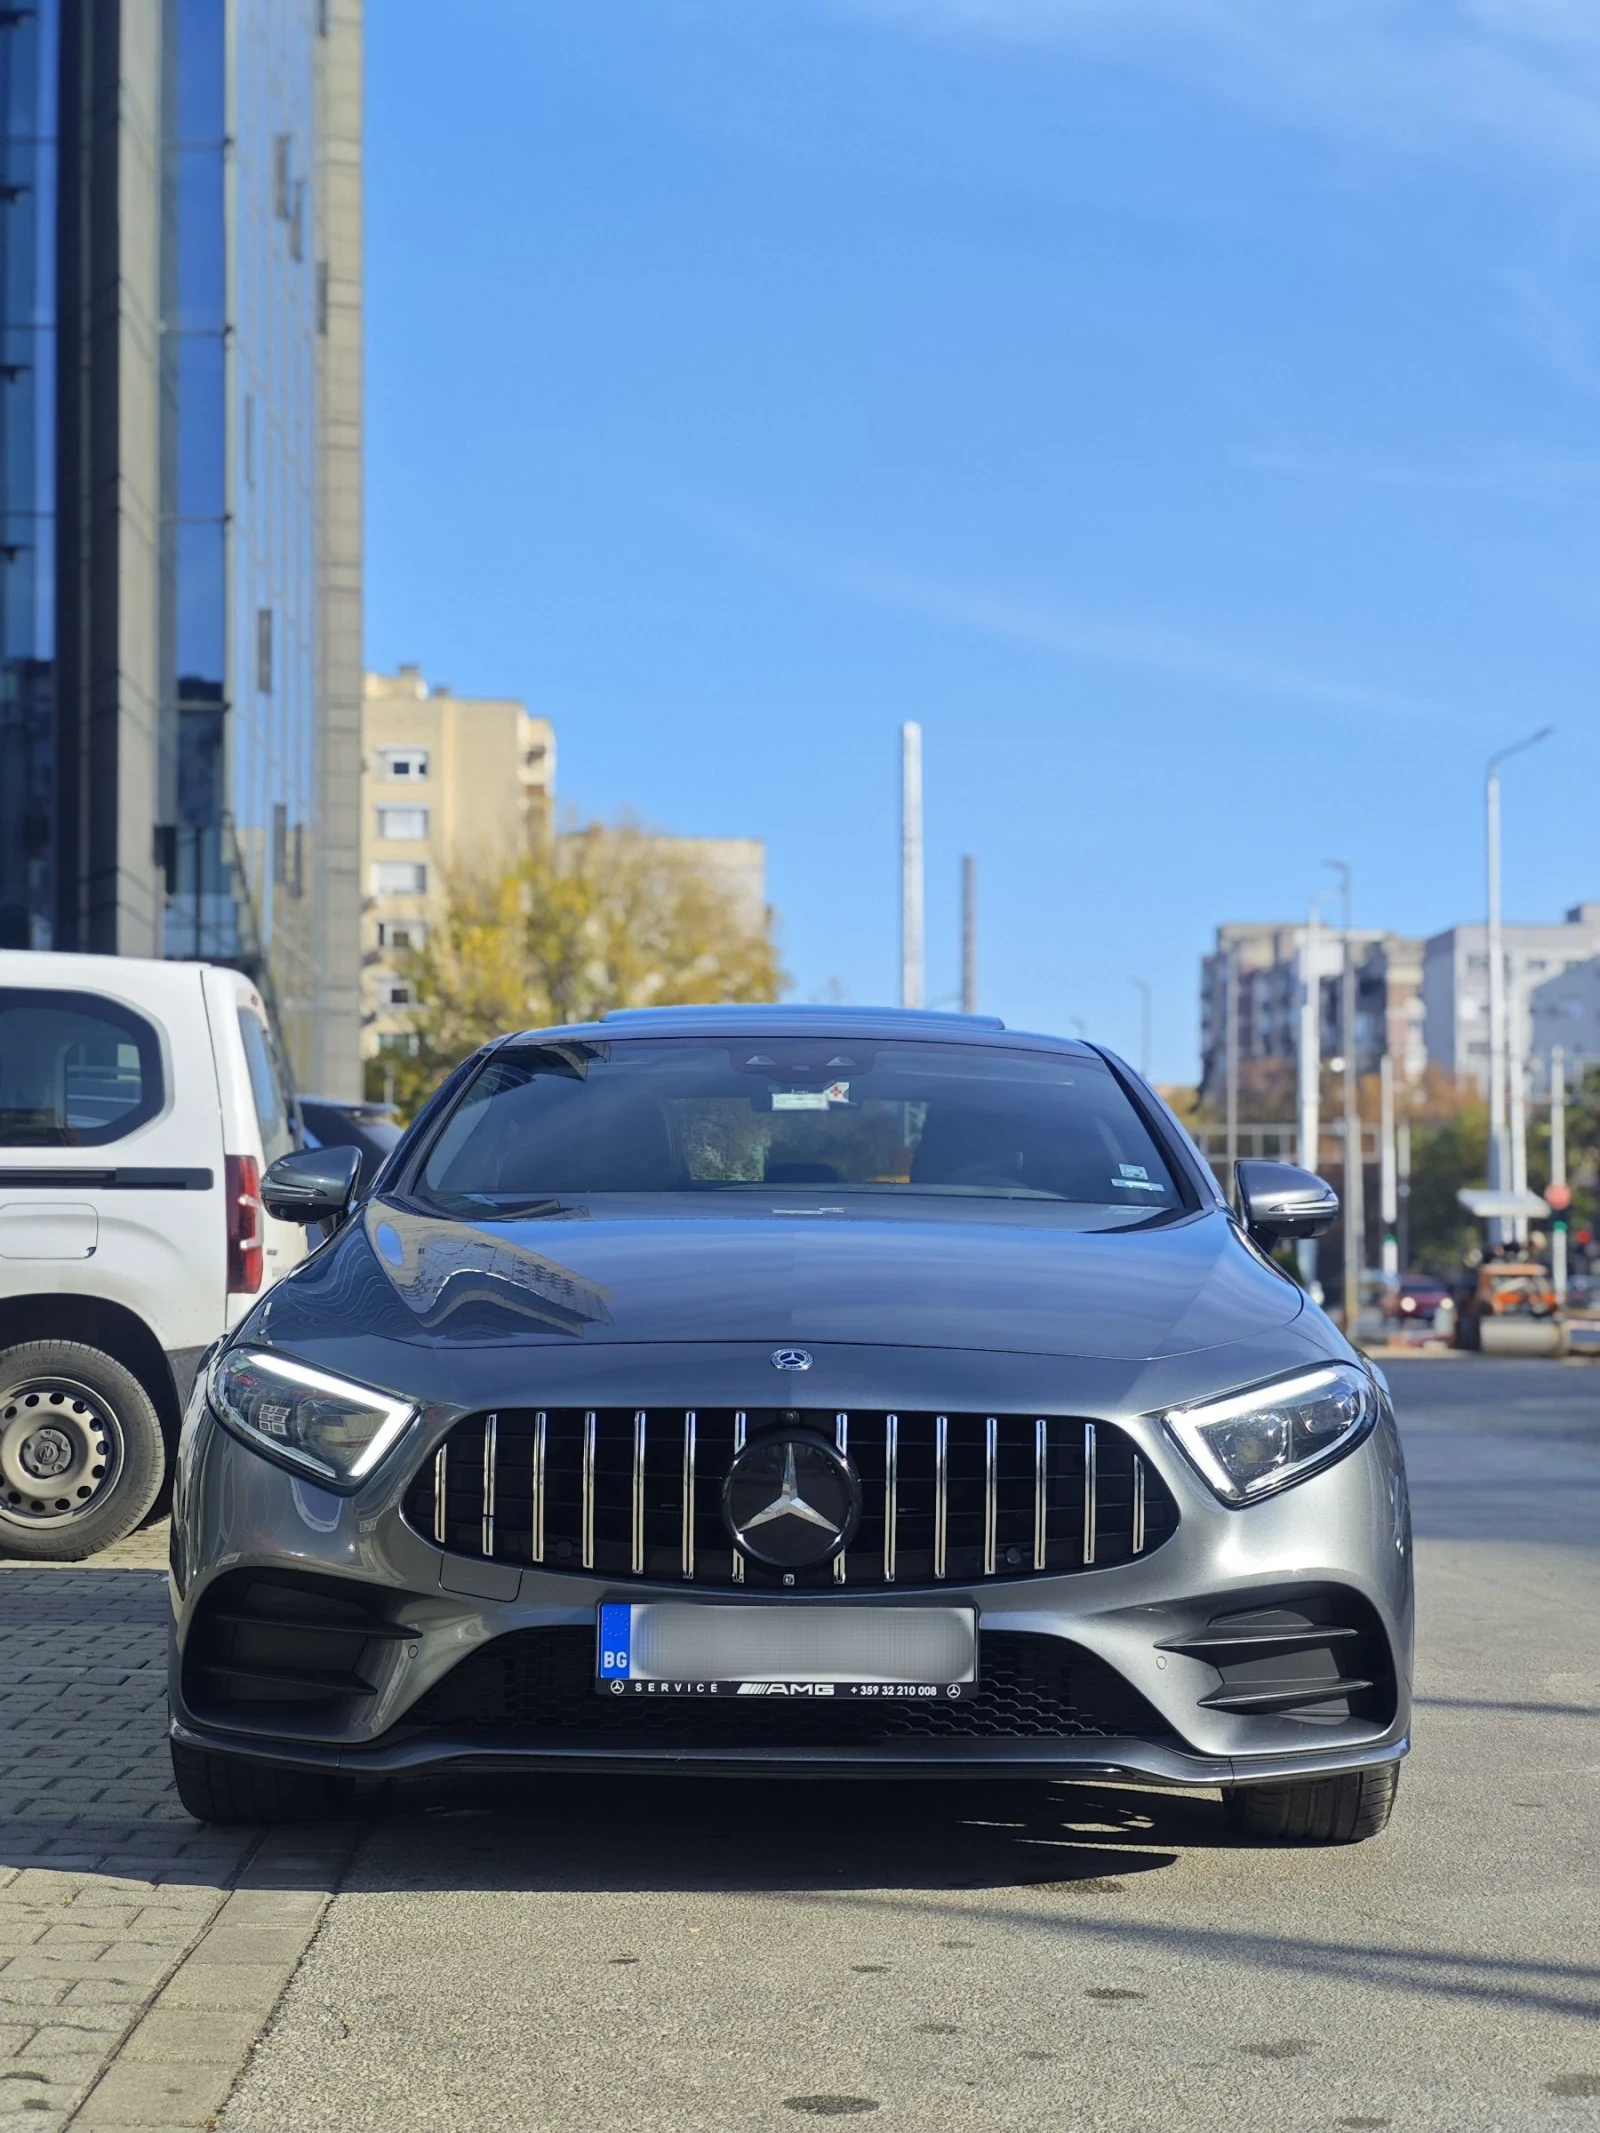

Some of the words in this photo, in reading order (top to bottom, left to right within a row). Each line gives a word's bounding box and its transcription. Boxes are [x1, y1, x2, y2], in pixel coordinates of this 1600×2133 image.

[603, 1651, 628, 1668] BG
[635, 1682, 718, 1693] SERVICE
[766, 1683, 835, 1696] AMG
[881, 1685, 895, 1696] 32
[896, 1685, 916, 1696] 210
[918, 1686, 937, 1696] 008
